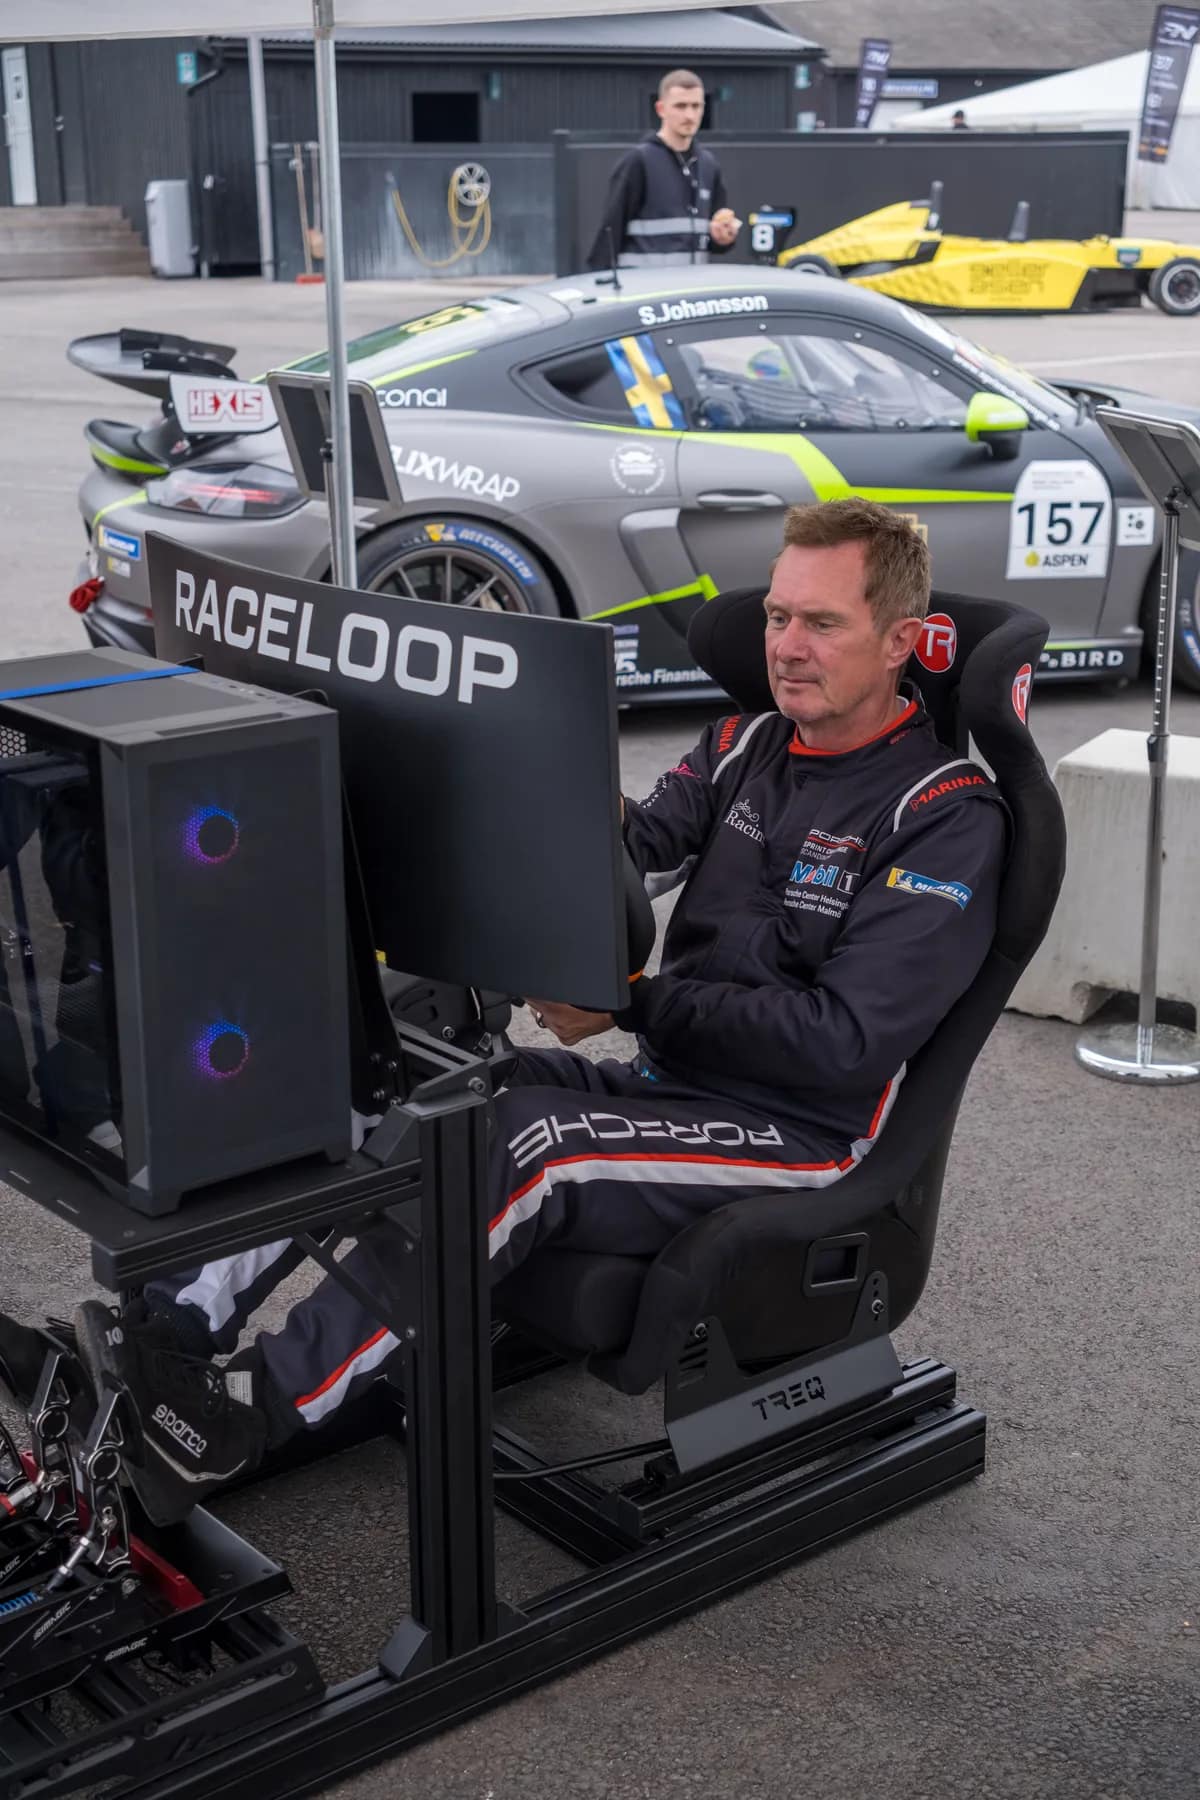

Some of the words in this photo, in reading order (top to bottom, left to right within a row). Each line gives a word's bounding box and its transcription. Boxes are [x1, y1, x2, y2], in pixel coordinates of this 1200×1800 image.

[752, 224, 774, 252] 8
[638, 295, 769, 325] S.Johansson
[188, 389, 264, 422] HEXIS
[1017, 502, 1105, 546] 157
[1042, 554, 1089, 568] ASPEN
[175, 569, 519, 704] RACELOOP
[724, 809, 766, 847] Racin
[105, 1326, 124, 1346] 10
[752, 1376, 826, 1421] TREQ
[152, 1403, 208, 1455] sparco
